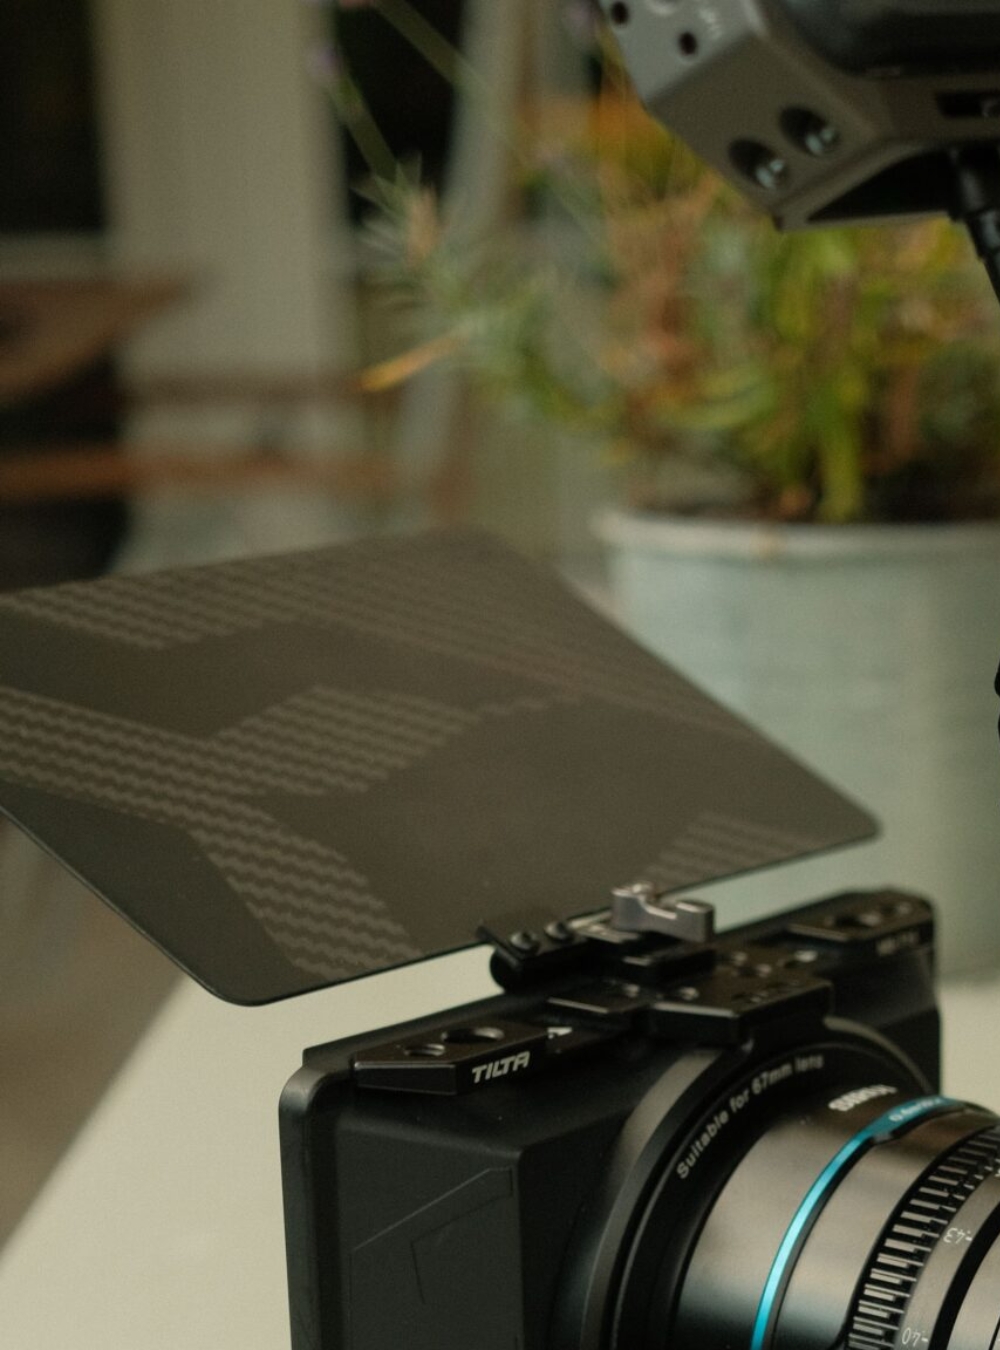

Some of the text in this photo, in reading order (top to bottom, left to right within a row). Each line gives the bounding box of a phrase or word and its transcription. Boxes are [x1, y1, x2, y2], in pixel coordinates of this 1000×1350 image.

[472, 1051, 530, 1084] TILTA
[676, 1111, 729, 1179] Suitable
[729, 1089, 750, 1113] for
[751, 1063, 793, 1095] 67mm
